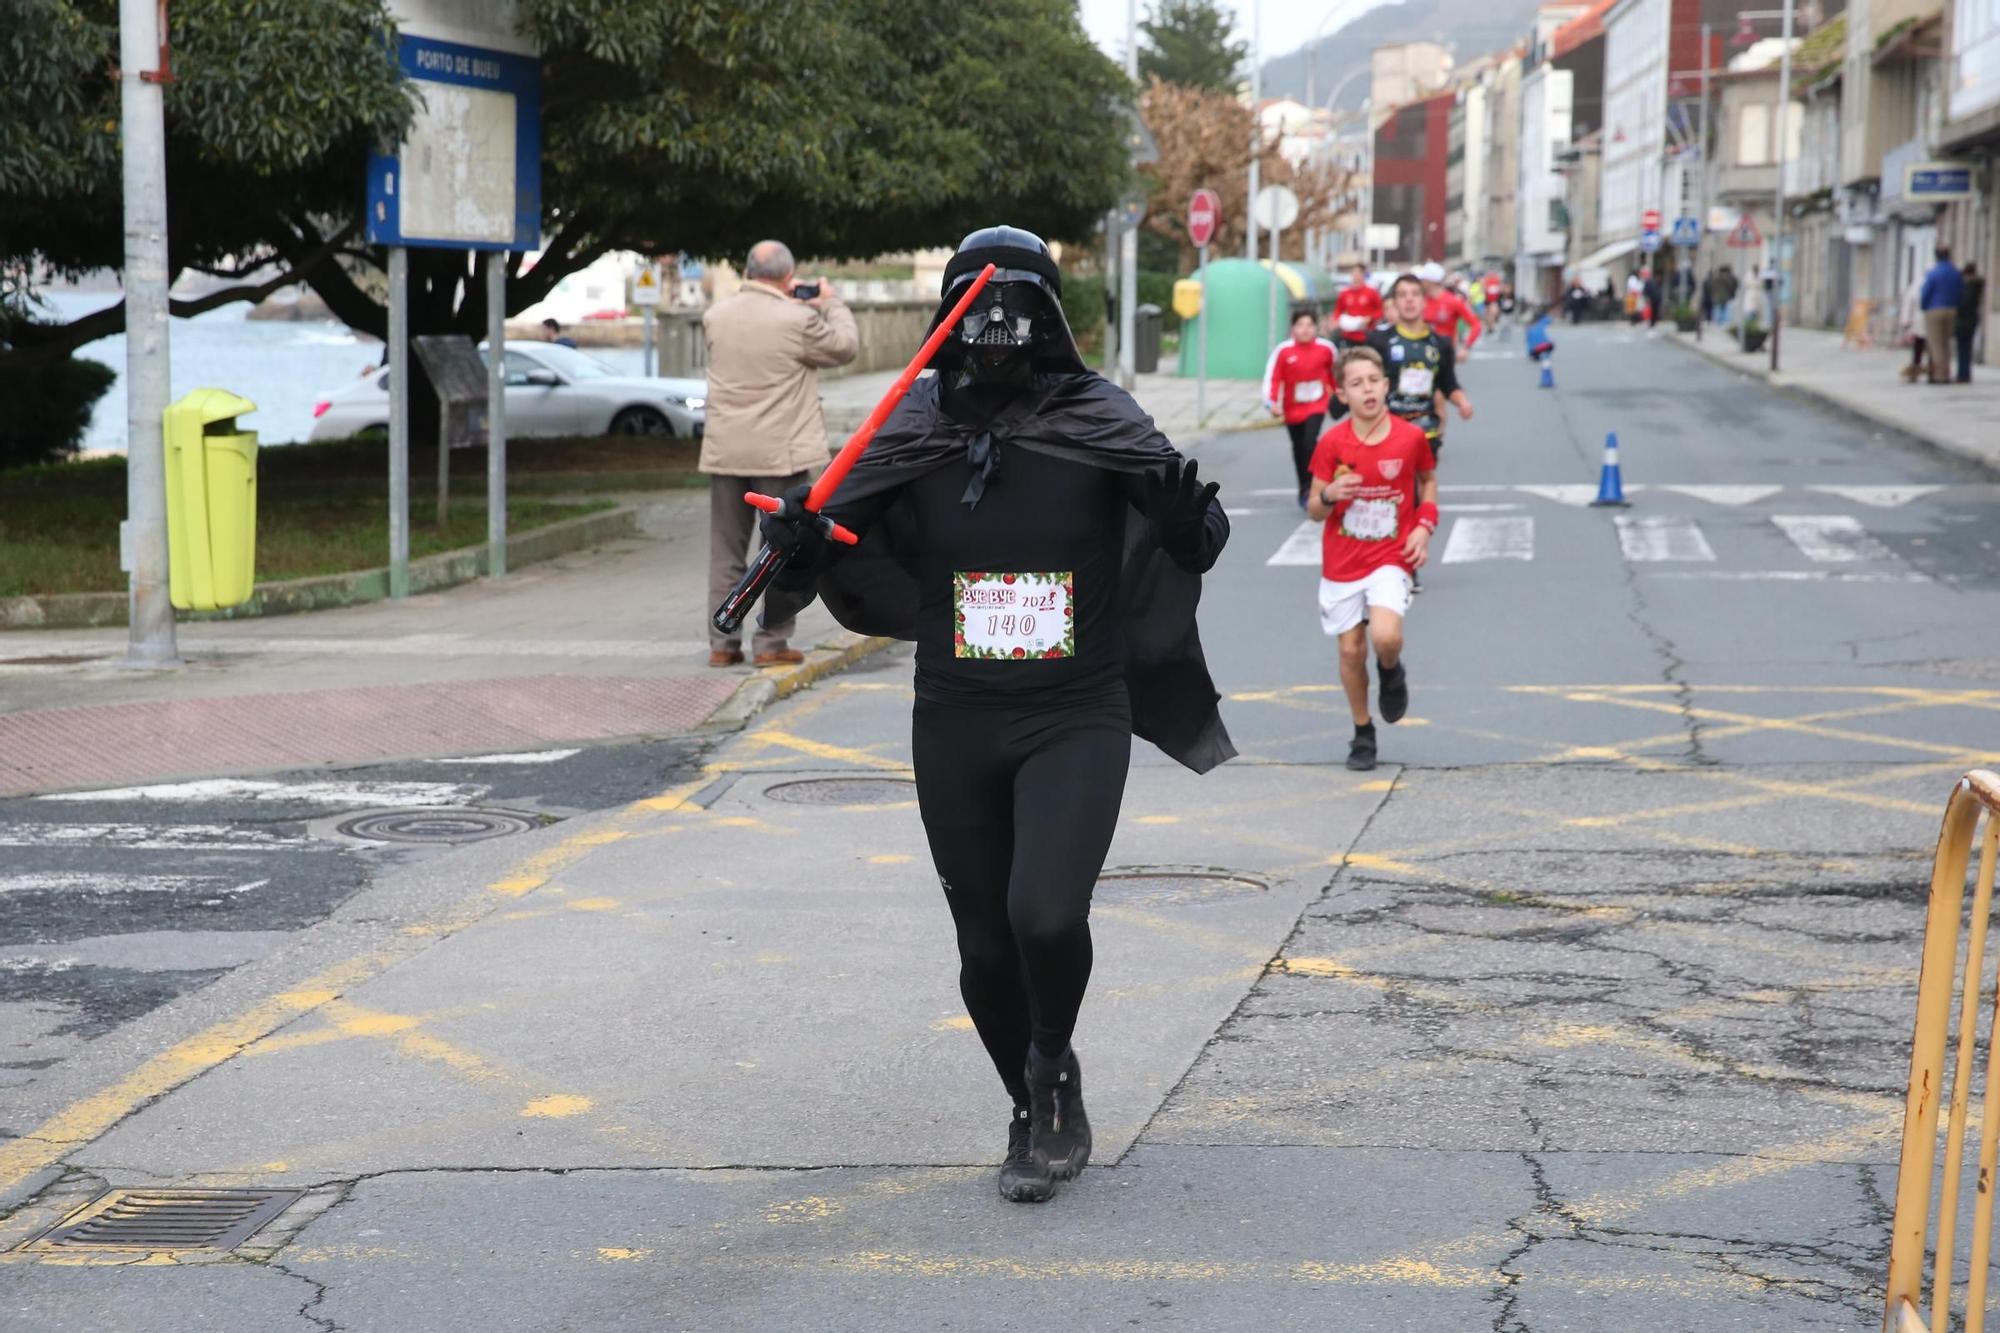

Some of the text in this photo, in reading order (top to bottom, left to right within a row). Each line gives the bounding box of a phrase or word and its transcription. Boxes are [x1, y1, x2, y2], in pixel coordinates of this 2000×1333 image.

[417, 49, 453, 73] PORTO
[455, 55, 470, 76] DE
[987, 614, 1036, 636] 140
